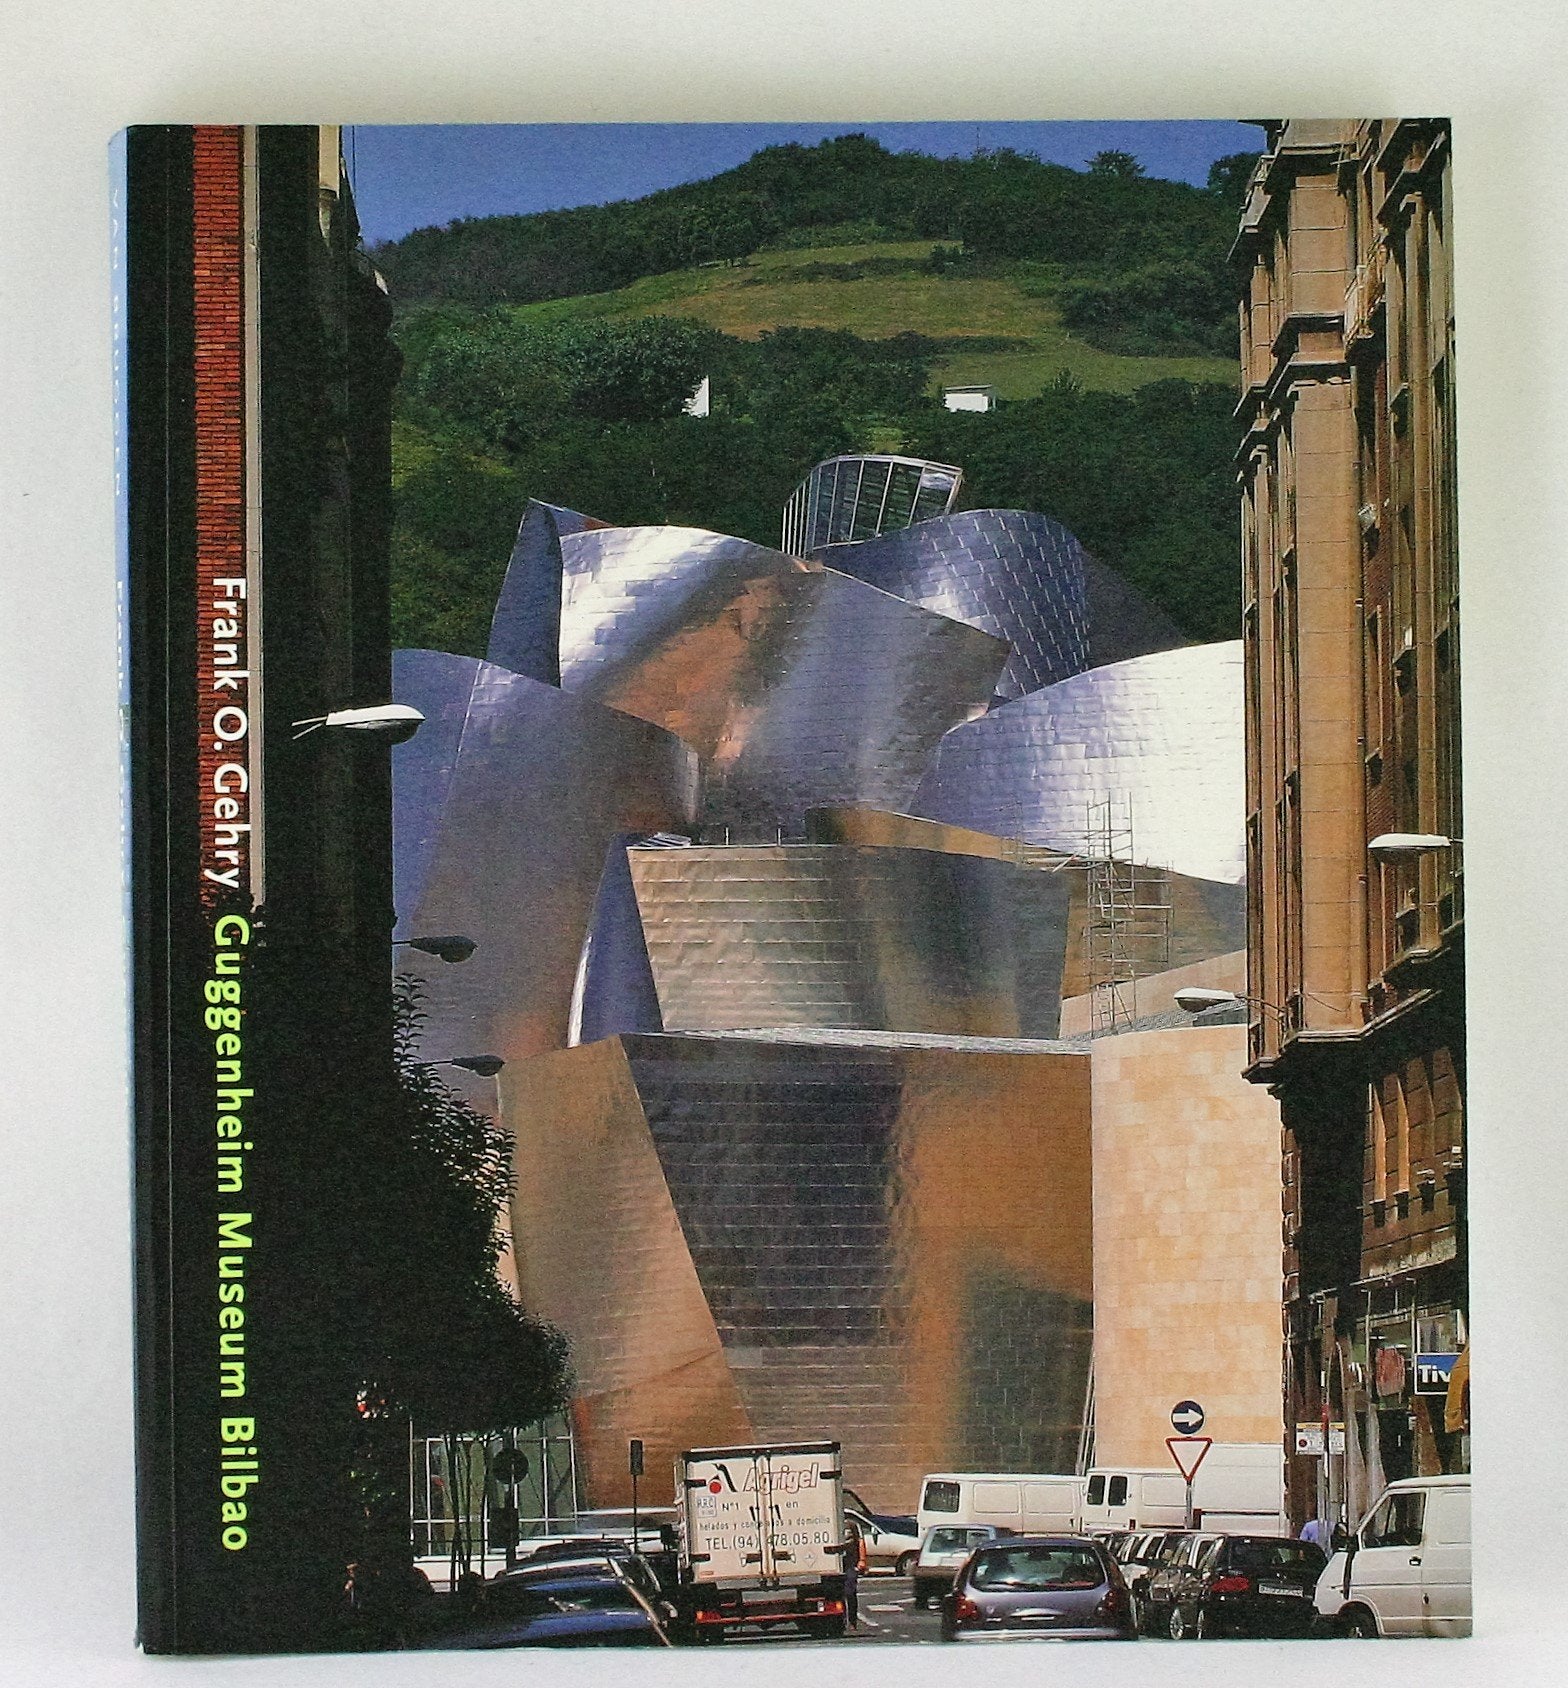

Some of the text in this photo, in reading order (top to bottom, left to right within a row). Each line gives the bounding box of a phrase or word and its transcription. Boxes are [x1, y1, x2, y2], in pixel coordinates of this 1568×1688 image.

[203, 578, 252, 888] Frank O. Gehry
[203, 914, 259, 1551] Guggenheim Museum Bilbao
[742, 1462, 820, 1495] Agrigel
